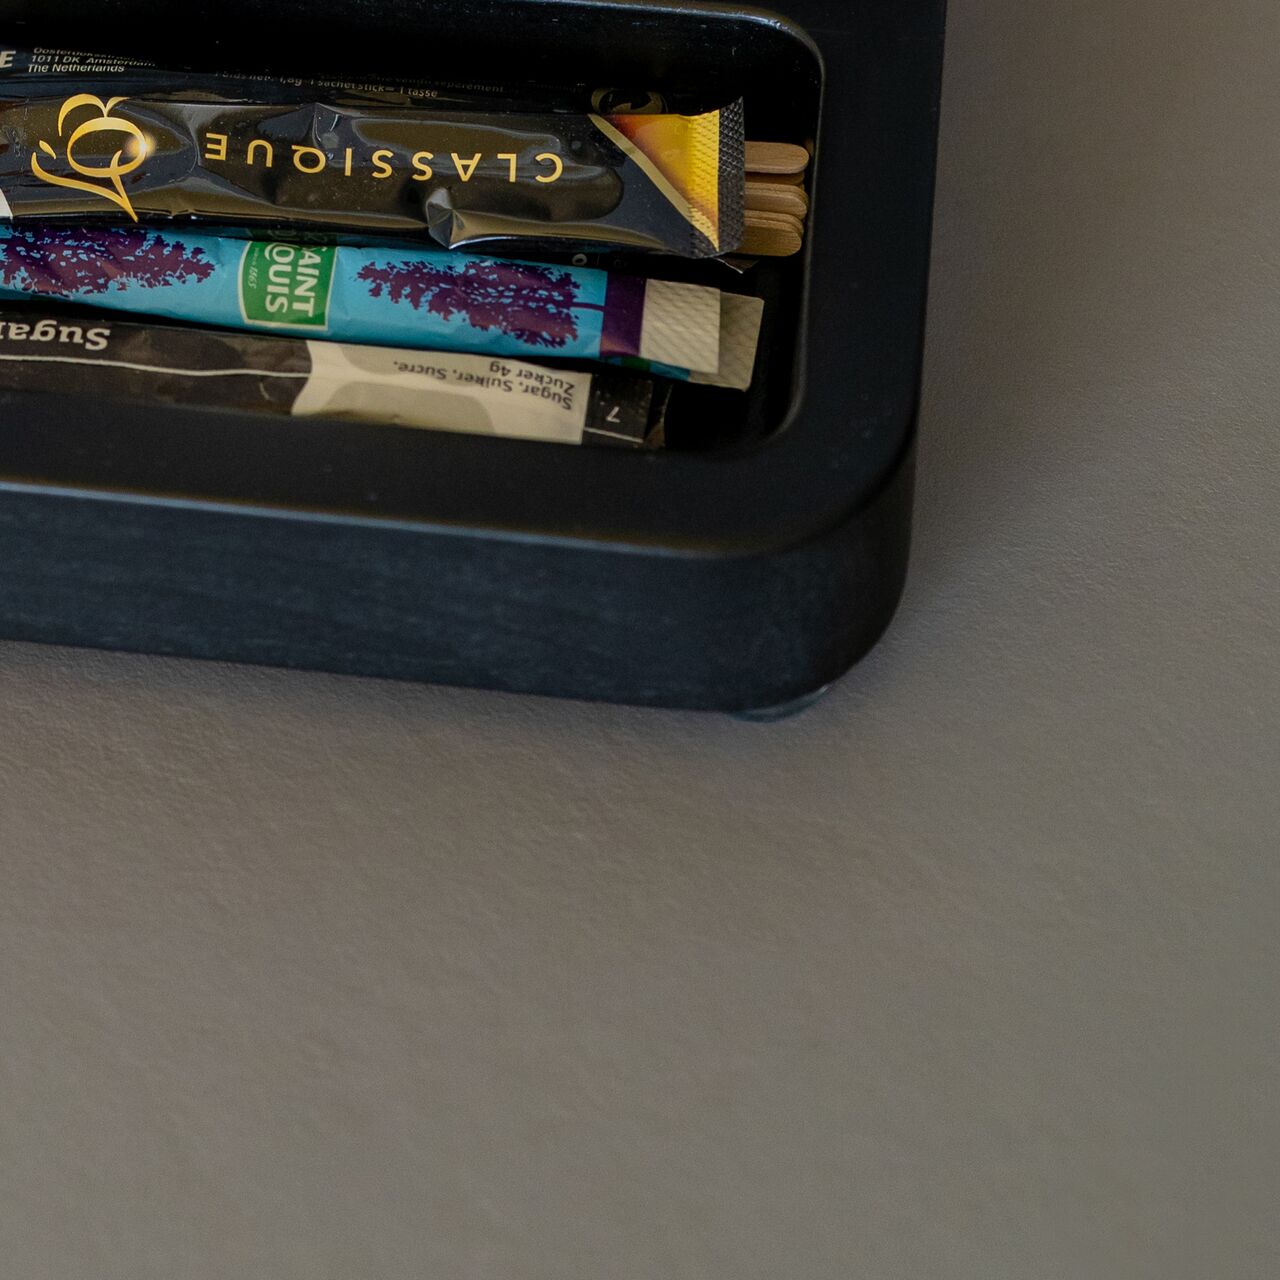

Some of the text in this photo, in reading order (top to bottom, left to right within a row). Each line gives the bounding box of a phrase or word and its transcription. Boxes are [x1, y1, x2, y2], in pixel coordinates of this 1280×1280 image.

[27, 62, 126, 73] The Netherlands
[62, 54, 81, 64] DK
[206, 130, 564, 184] CLASSIQUE
[488, 359, 576, 397] Zucker 4g
